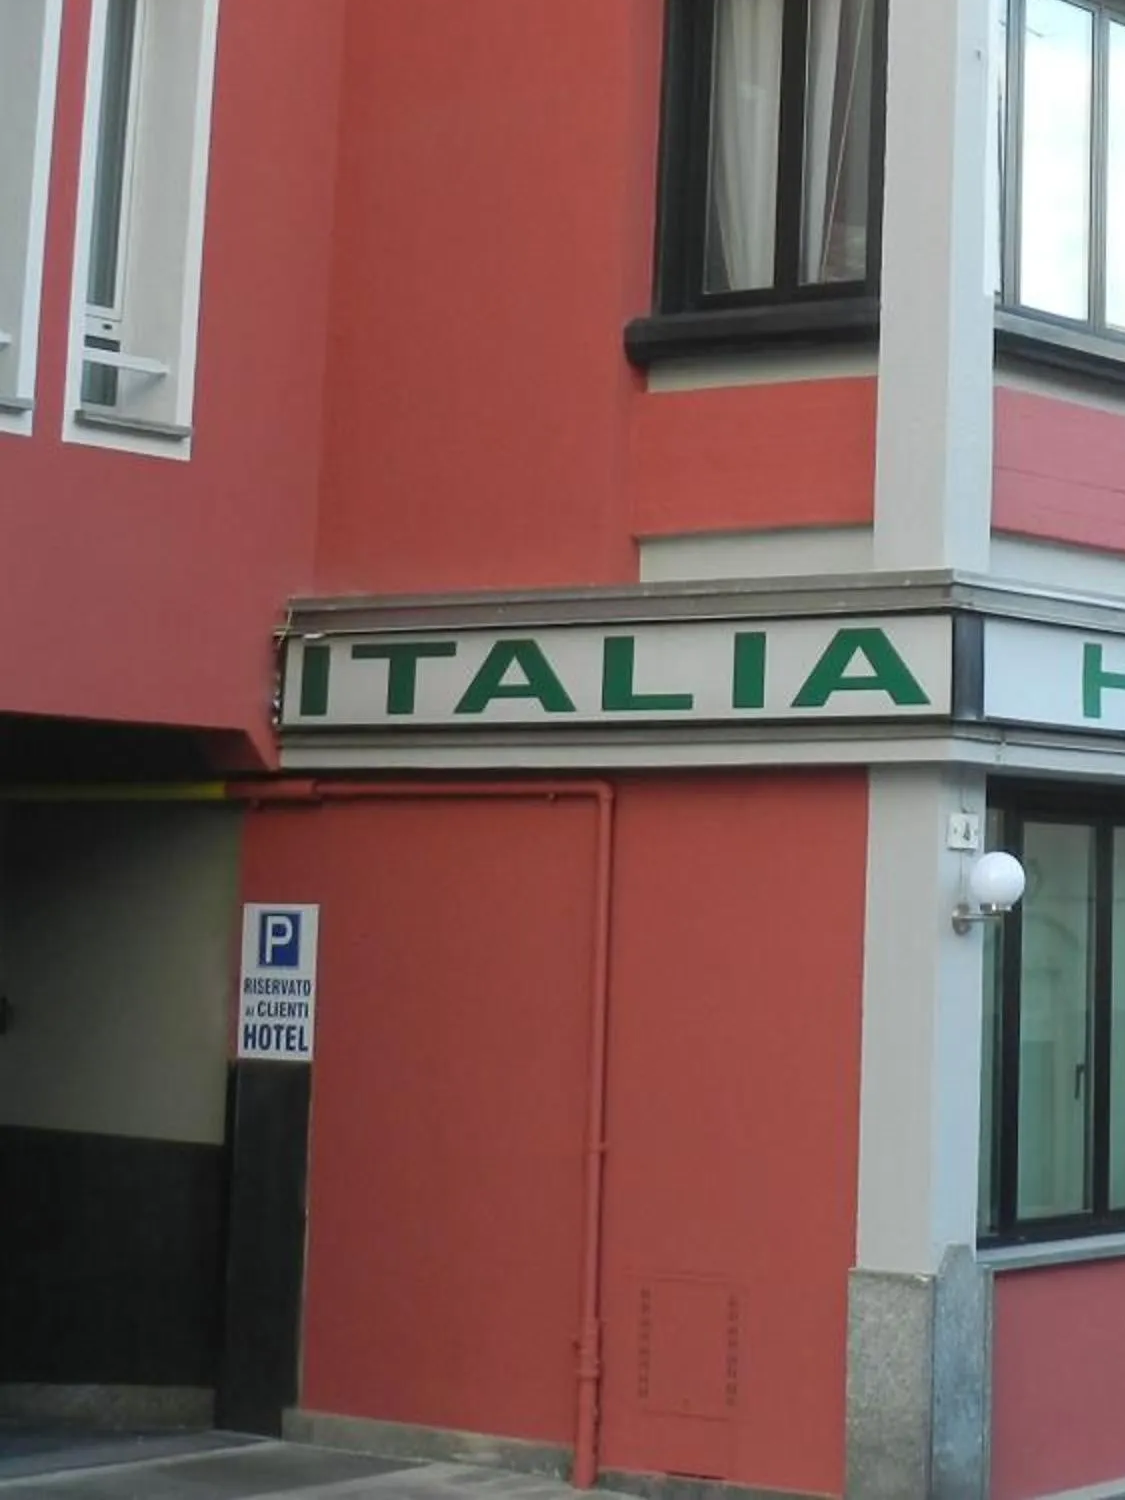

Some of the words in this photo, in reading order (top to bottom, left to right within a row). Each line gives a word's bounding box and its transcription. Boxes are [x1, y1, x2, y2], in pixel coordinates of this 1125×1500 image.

[300, 627, 931, 715] ITALIA
[265, 915, 293, 964] P
[244, 977, 311, 996] RISERVATO
[257, 1001, 309, 1018] CLIENTI
[244, 1024, 309, 1051] HOTEL
